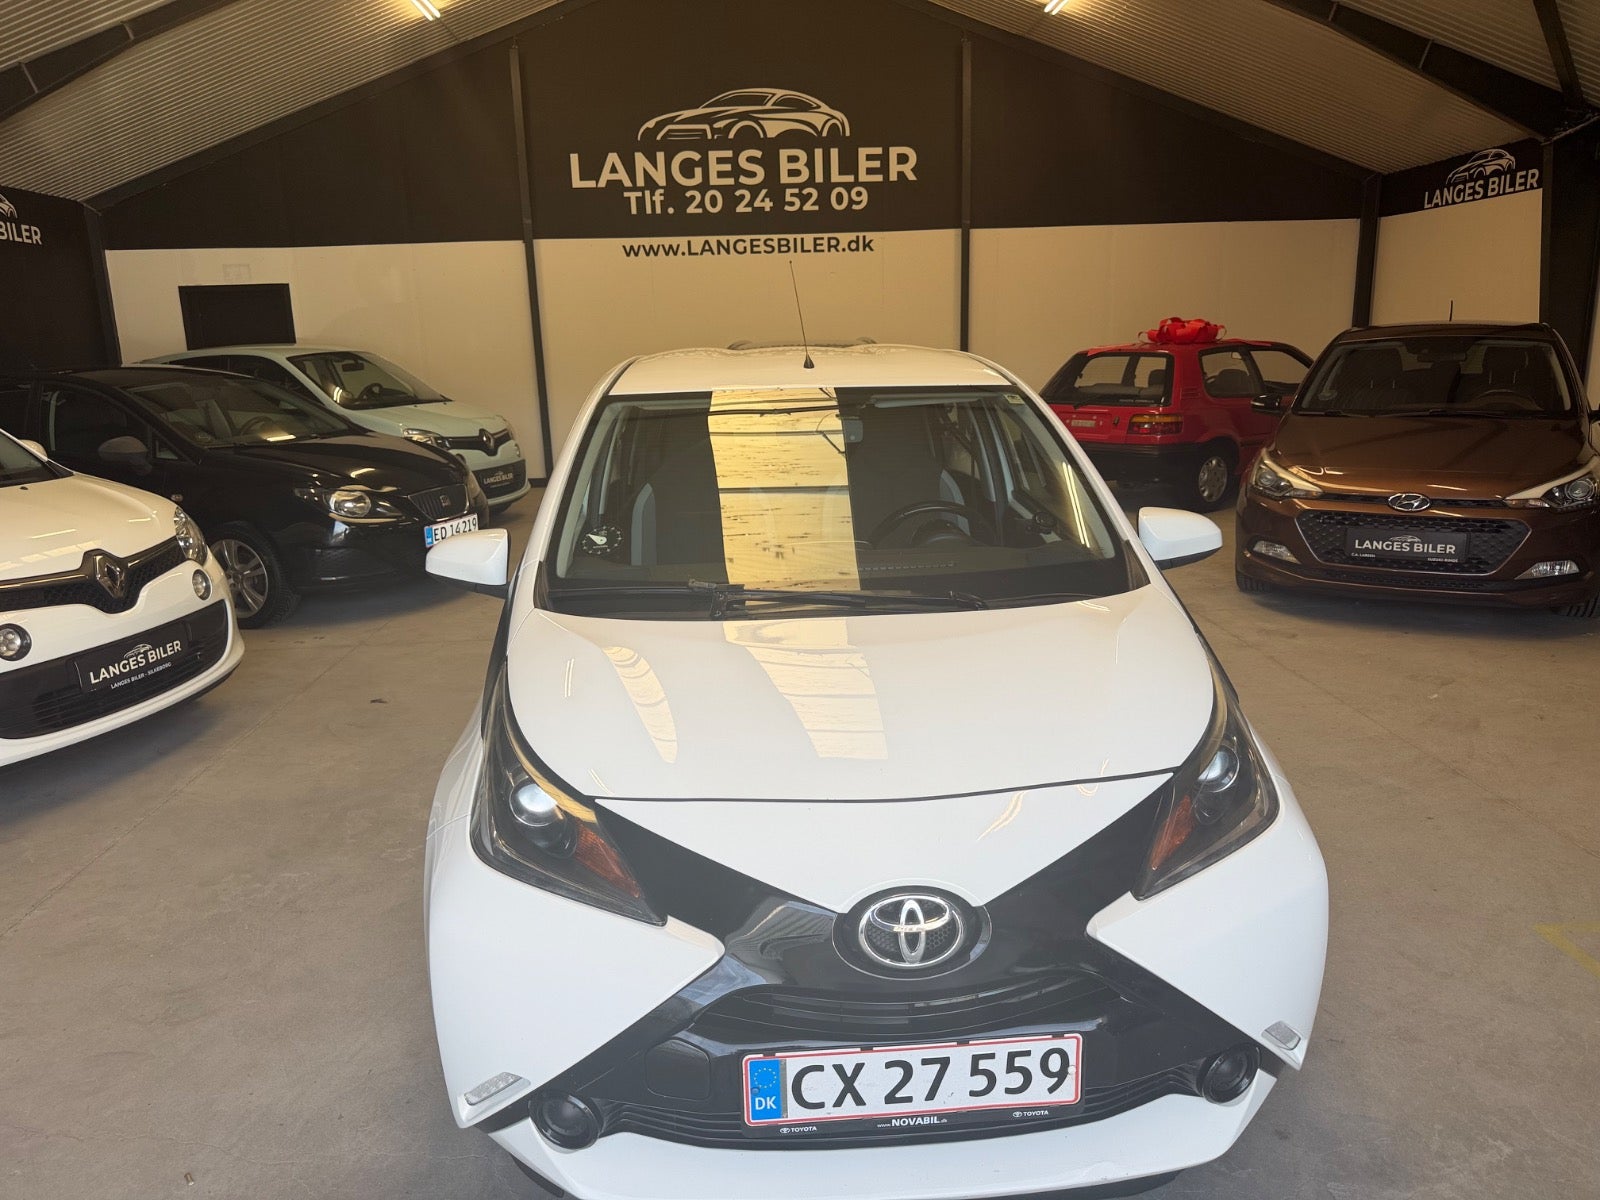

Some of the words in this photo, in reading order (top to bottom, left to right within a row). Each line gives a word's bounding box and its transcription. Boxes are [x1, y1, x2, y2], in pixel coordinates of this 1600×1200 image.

[569, 149, 766, 189] LANGES
[778, 146, 918, 185] BILER
[623, 189, 675, 215] Tlf.
[685, 189, 723, 214] 20
[734, 188, 774, 213] 24
[783, 186, 820, 212] 52
[830, 185, 869, 211] 09
[1424, 179, 1484, 209] LANGES
[1487, 168, 1540, 197] BILER
[0, 220, 42, 245] BILER
[621, 234, 875, 258] www.LANGESBILER.dk
[433, 526, 447, 542] ED
[449, 522, 461, 537] 14
[462, 517, 477, 534] 219
[1355, 539, 1410, 552] LANGES
[1413, 542, 1456, 554] BILER
[89, 653, 146, 684] LANGES
[147, 640, 182, 663] BILER
[131, 672, 145, 683] BILER
[791, 1062, 867, 1110] CX
[884, 1056, 950, 1104] 27
[968, 1047, 1070, 1098] 559
[755, 1096, 777, 1110] DK
